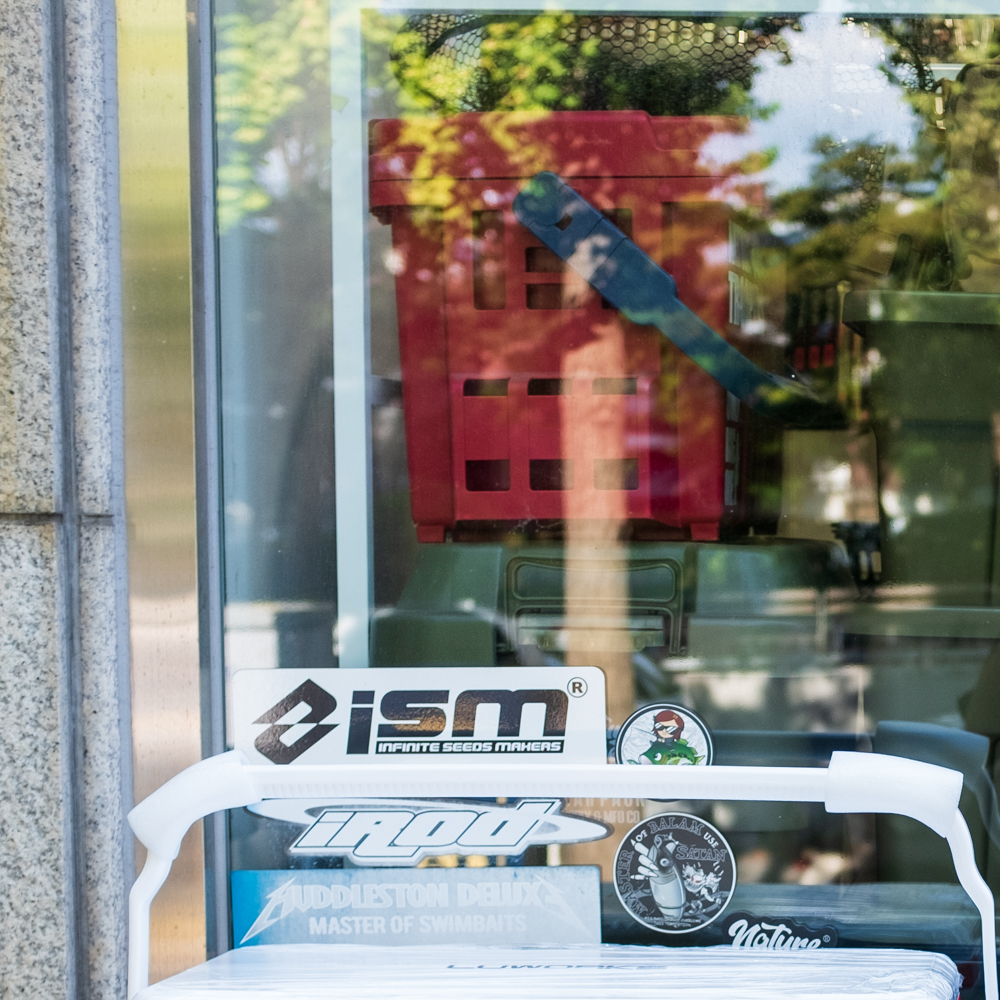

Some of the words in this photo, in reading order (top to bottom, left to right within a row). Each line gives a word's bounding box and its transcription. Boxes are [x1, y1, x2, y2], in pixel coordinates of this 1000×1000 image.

[346, 689, 569, 755] ism
[378, 741, 440, 753] INFINITE
[442, 741, 492, 753] SEEDS
[494, 741, 561, 752] MAKERS
[635, 829, 649, 842] OF
[647, 817, 705, 836] BALAM
[703, 831, 719, 849] USE
[675, 845, 728, 862] SATAN
[309, 916, 386, 935] MASTER
[390, 915, 413, 934] OF
[418, 914, 527, 934] SWIMBAITS
